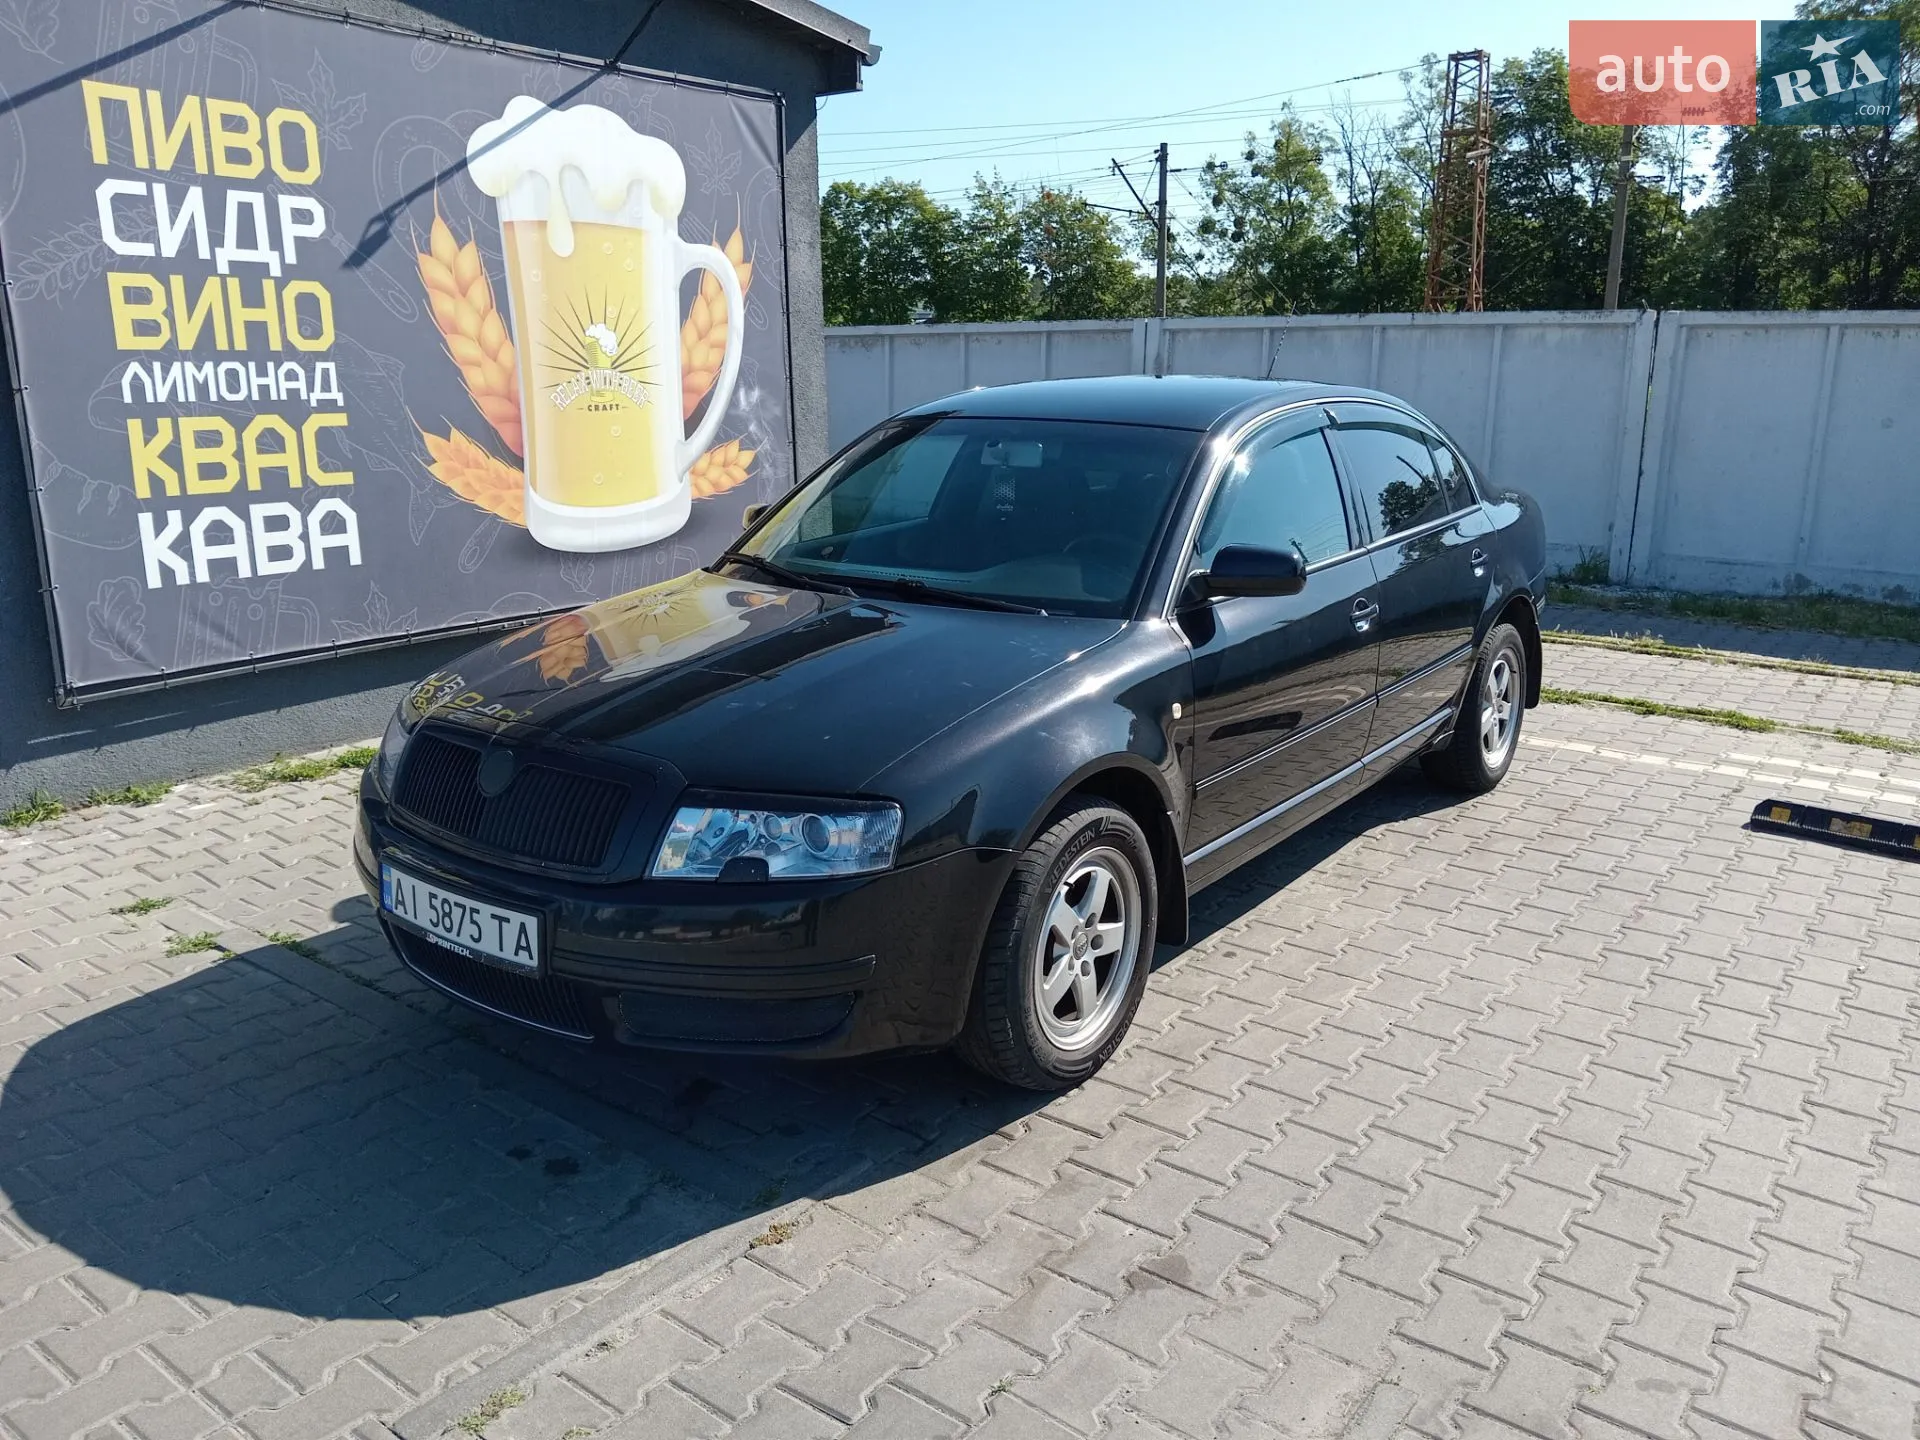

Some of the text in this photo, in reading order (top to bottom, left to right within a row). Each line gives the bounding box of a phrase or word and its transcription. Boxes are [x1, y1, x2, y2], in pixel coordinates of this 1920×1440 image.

[81, 79, 321, 185] ПИВО
[95, 178, 326, 277] СИДР
[107, 271, 335, 352] ВИНО
[121, 361, 344, 407] ЛИМОНАД
[550, 369, 649, 411] RELAX WITH BEER
[587, 404, 620, 412] CRAFT
[127, 413, 354, 499] КВАС
[137, 497, 362, 589] КАВА
[394, 878, 534, 960] AI 5875 TA
